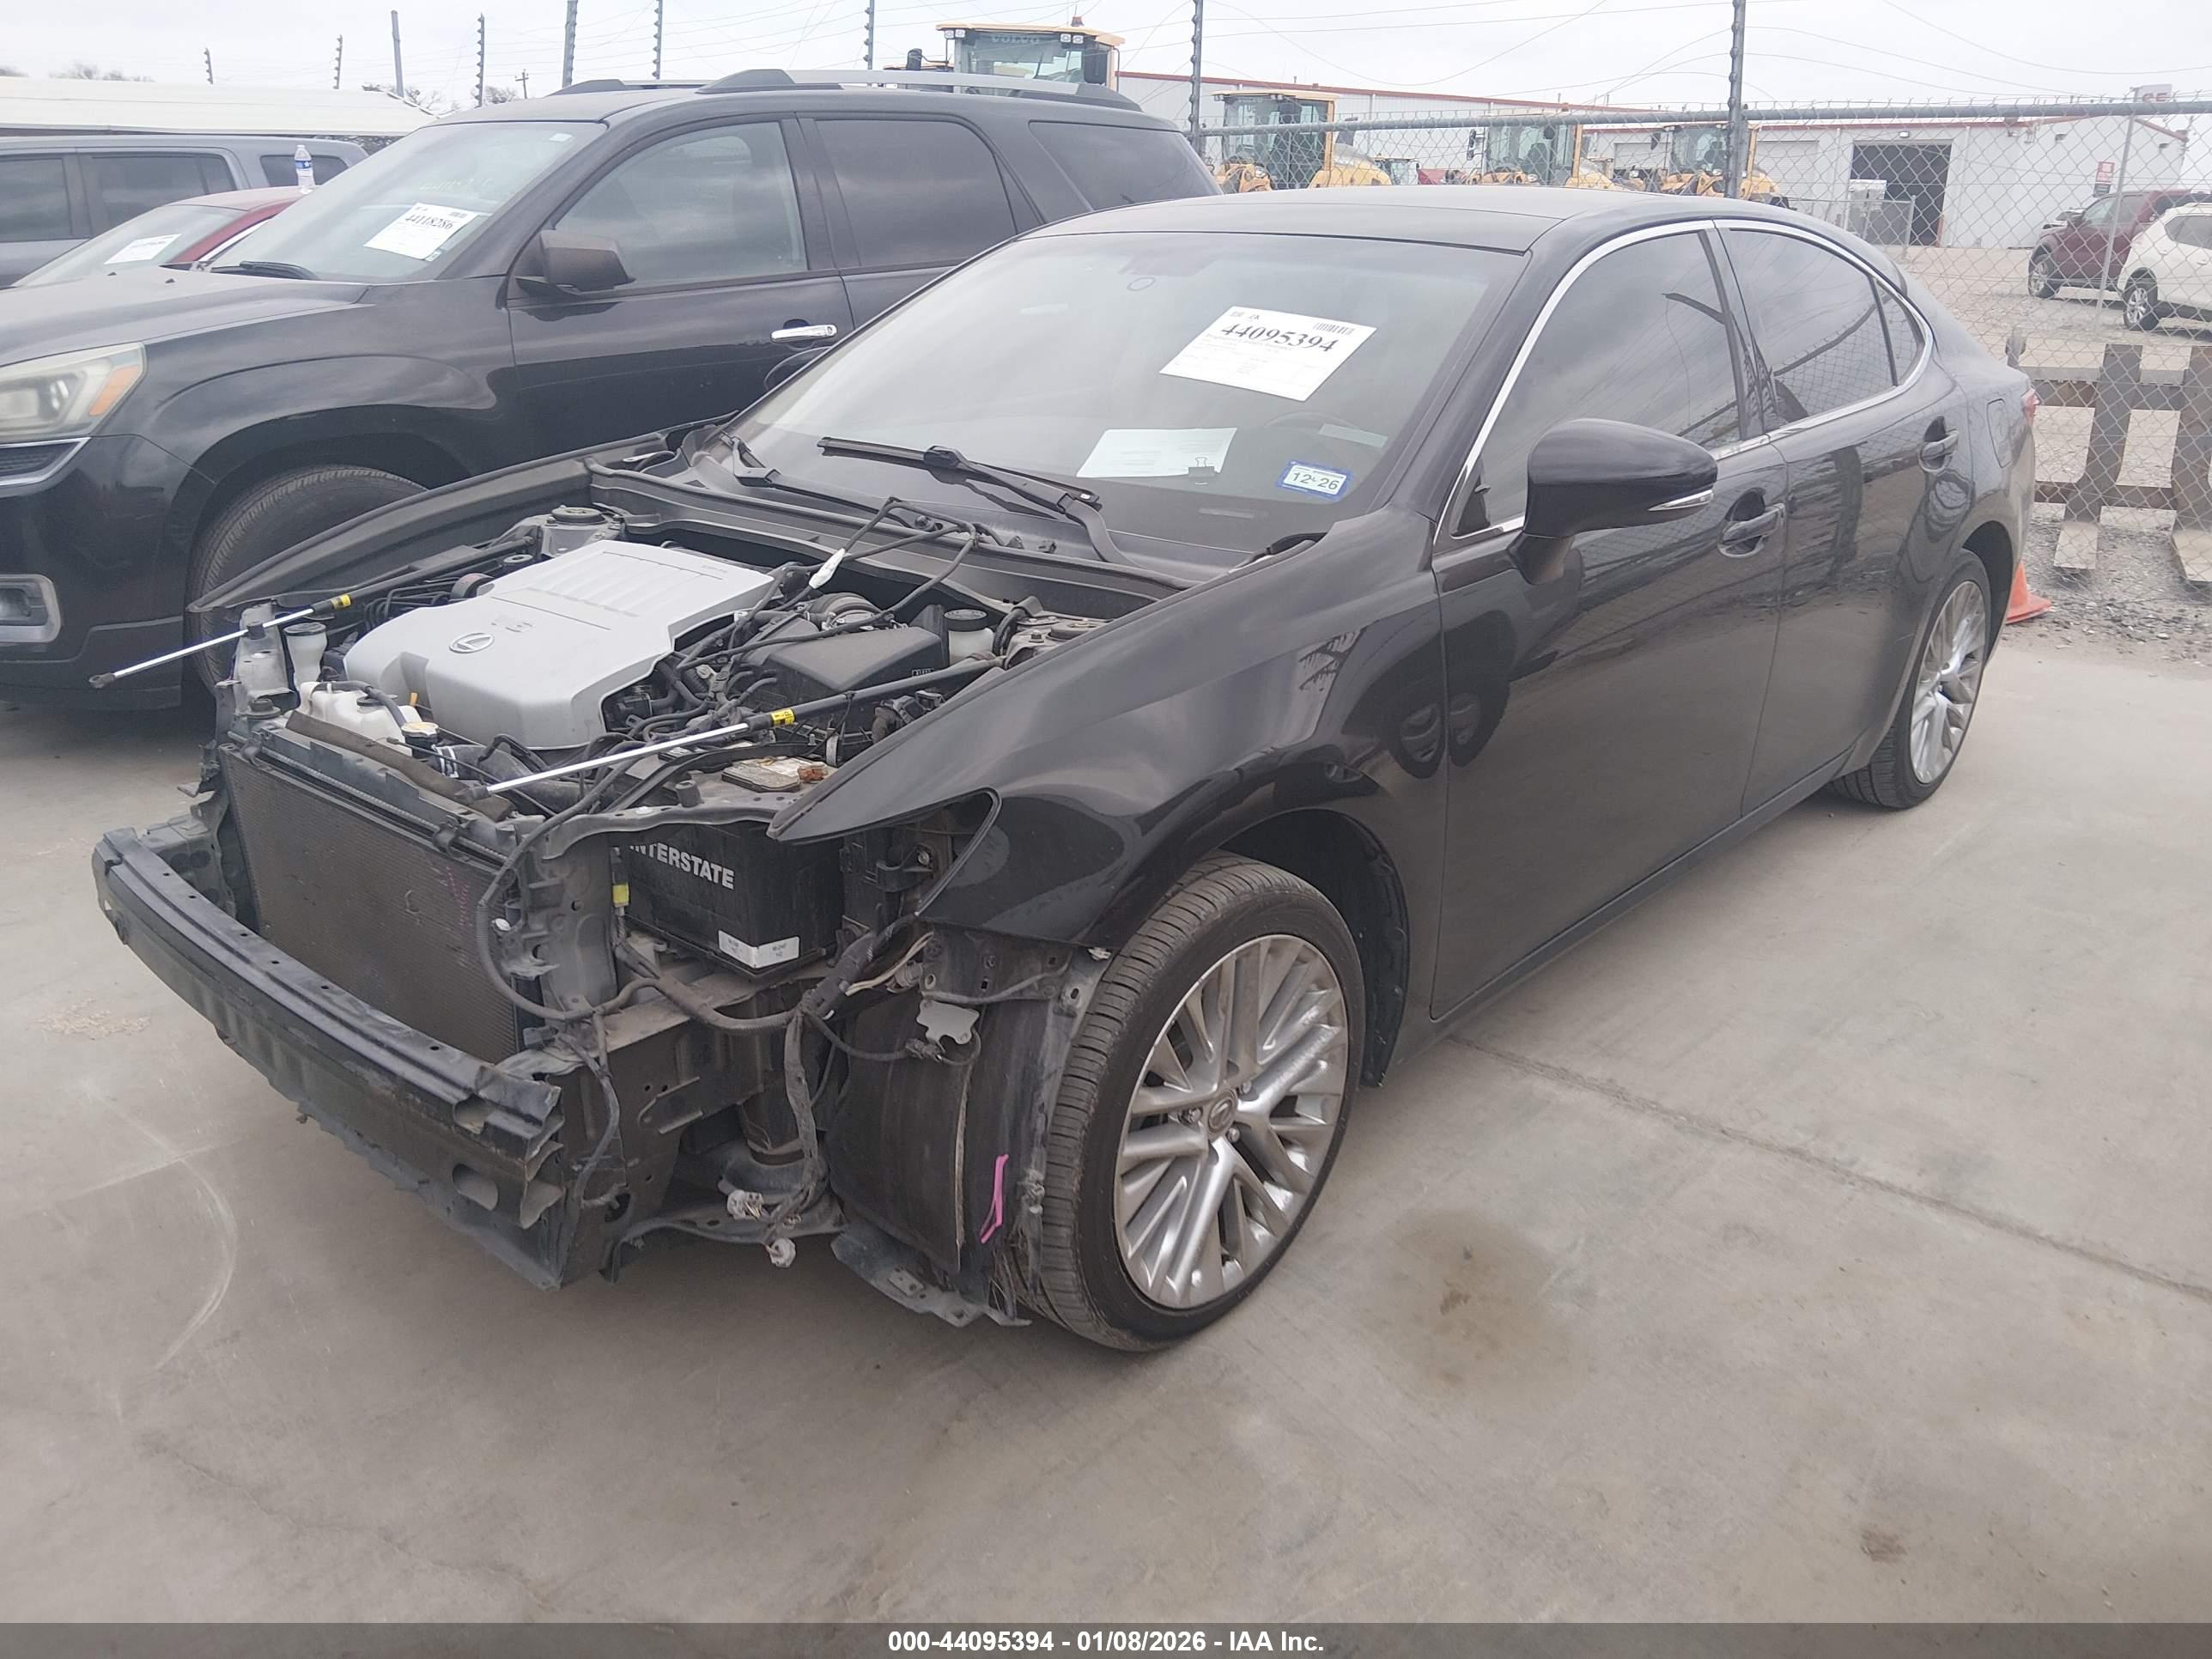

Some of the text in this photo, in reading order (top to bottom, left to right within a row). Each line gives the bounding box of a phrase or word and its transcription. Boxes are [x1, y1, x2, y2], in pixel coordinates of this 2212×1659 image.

[1221, 323, 1340, 353] 44095394
[1292, 471, 1340, 490] 12 26
[629, 841, 735, 890] NTERSTATE
